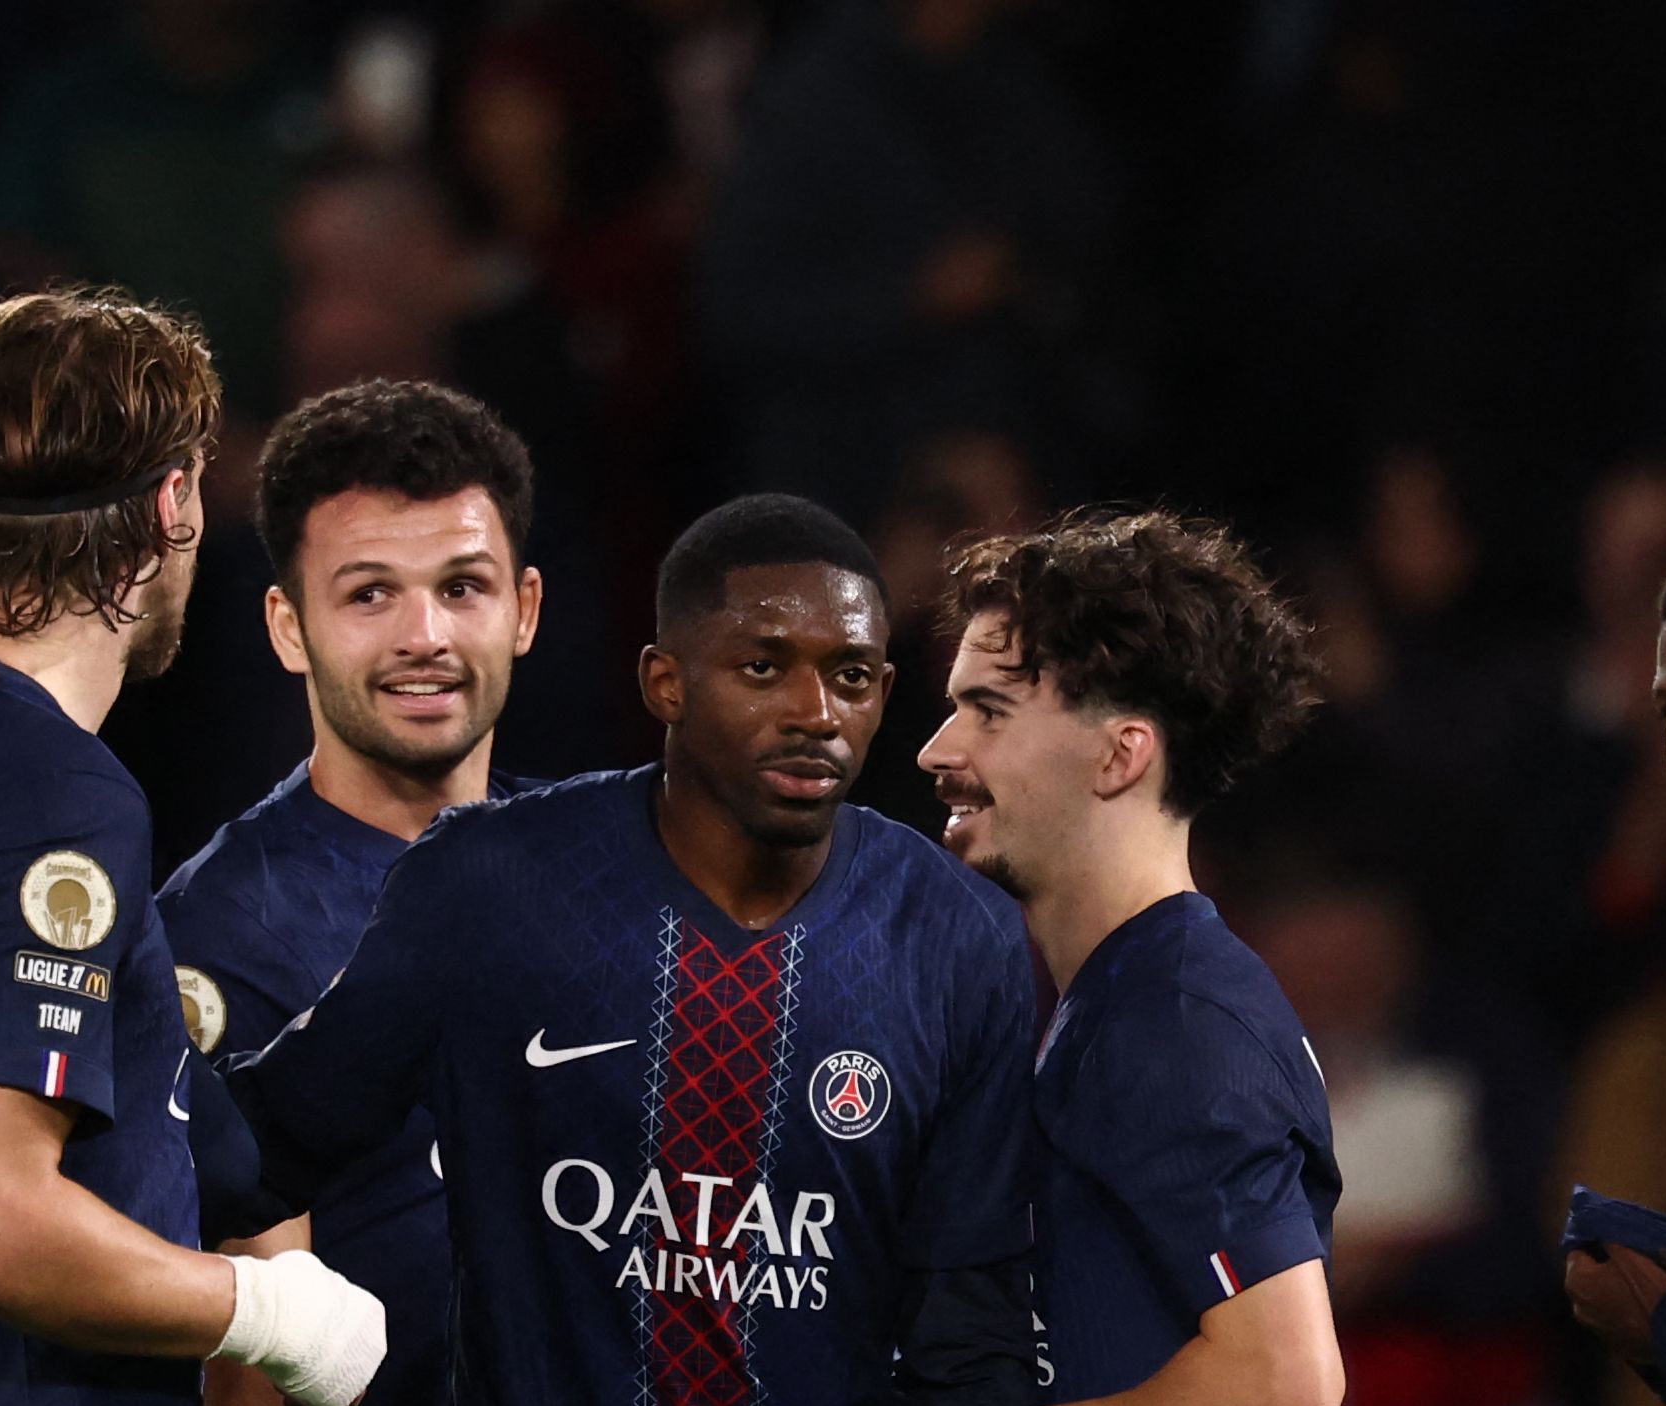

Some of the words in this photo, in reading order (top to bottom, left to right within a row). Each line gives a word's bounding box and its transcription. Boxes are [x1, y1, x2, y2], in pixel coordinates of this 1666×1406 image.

[17, 956, 69, 987] LIGUE
[826, 1055, 881, 1081] PARIS
[541, 1158, 835, 1260] QATAR
[614, 1245, 829, 1311] AIRWAYS
